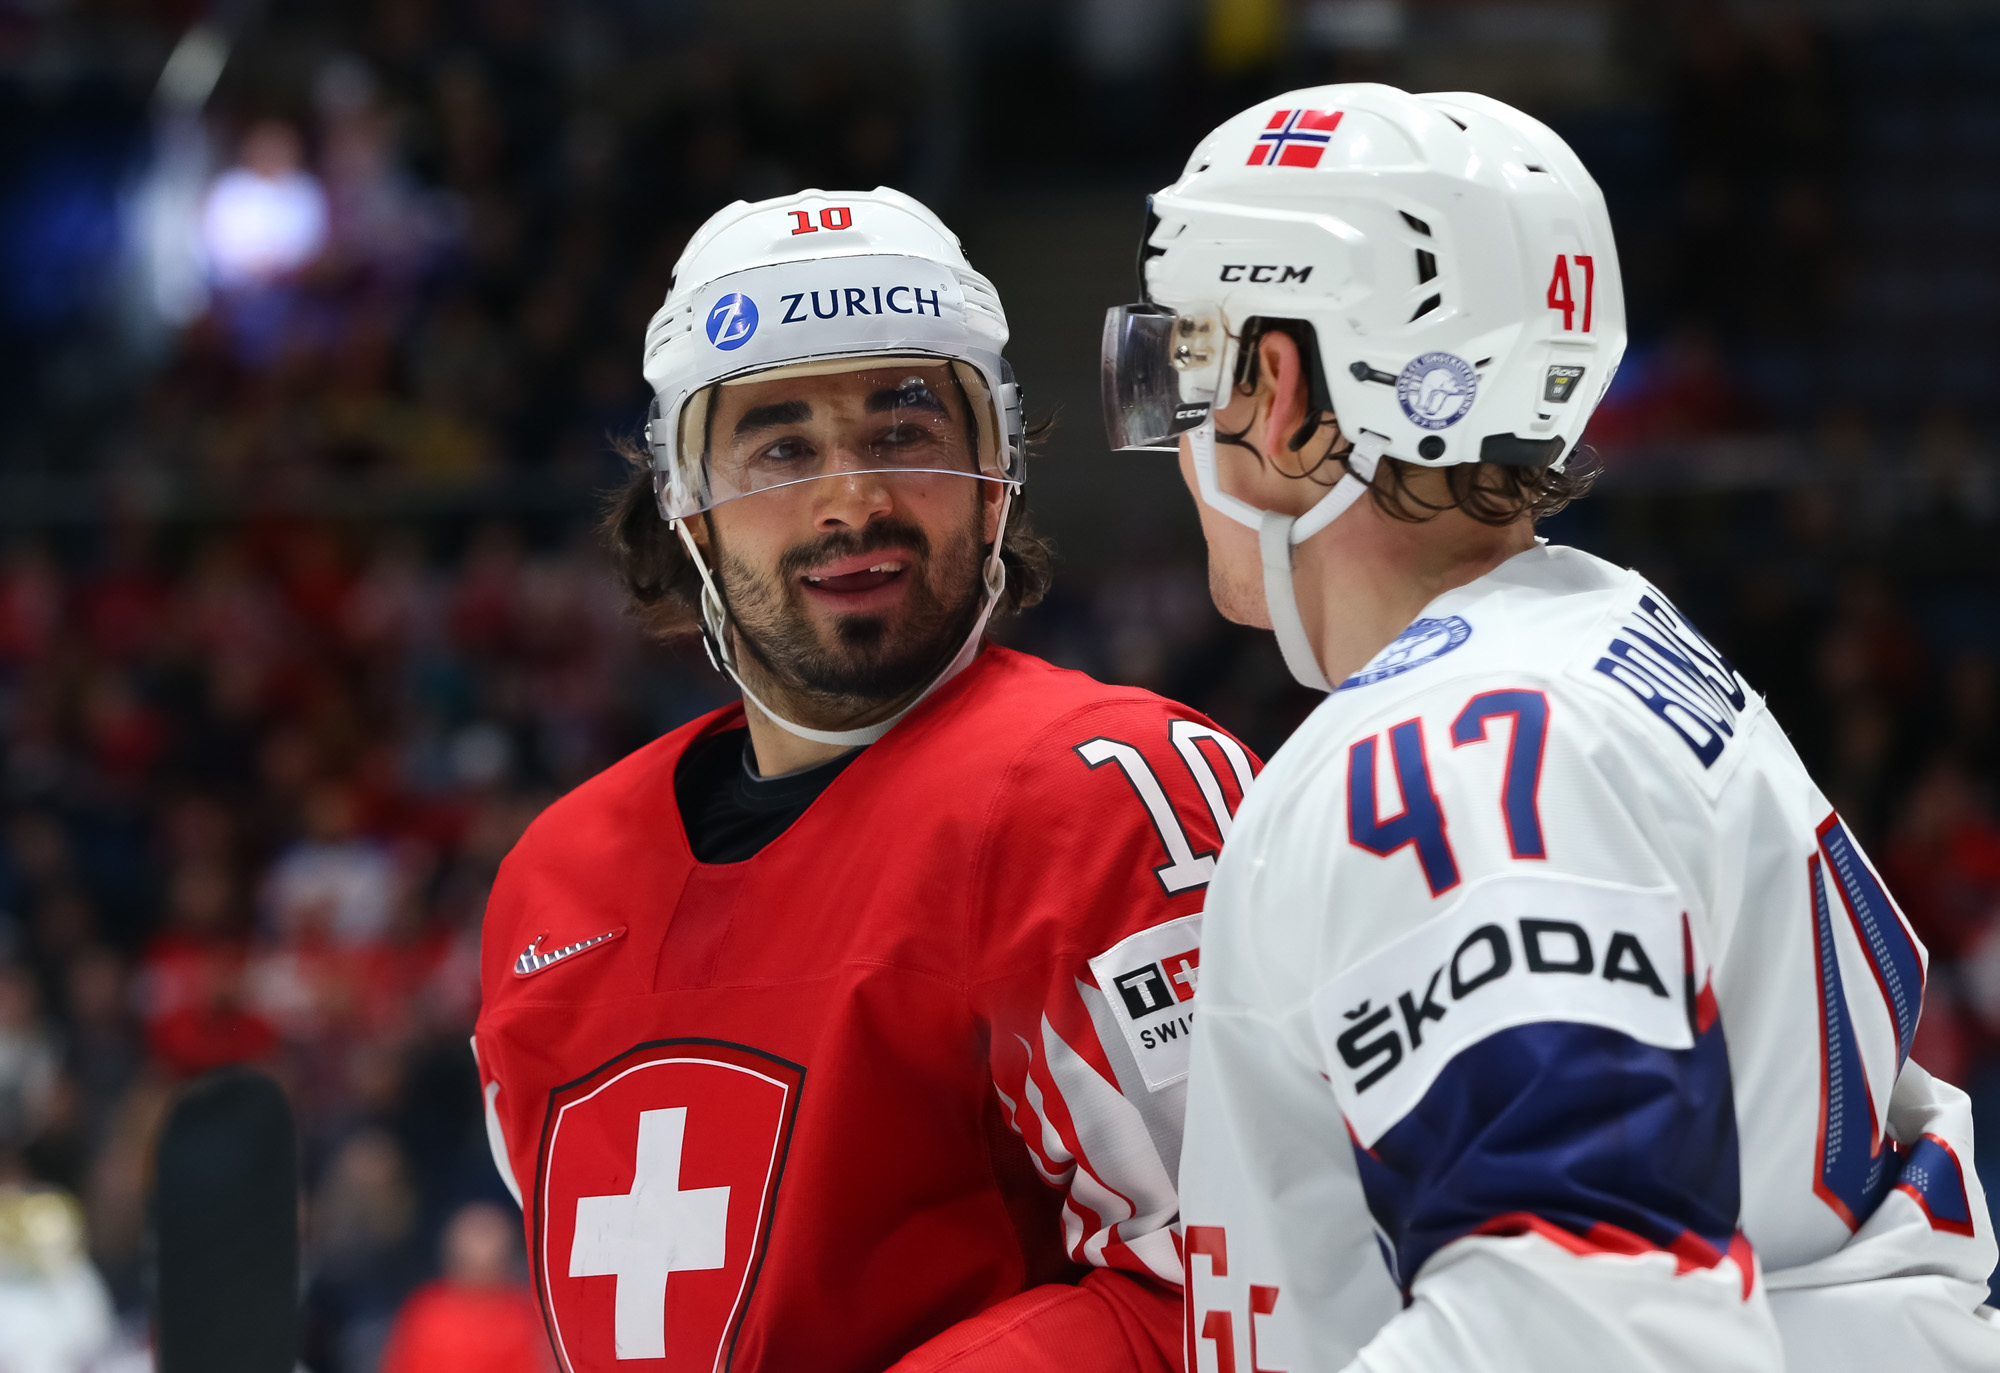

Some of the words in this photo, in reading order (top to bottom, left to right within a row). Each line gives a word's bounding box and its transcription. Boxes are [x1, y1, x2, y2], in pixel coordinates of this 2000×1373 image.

[788, 207, 852, 235] 10
[1219, 264, 1314, 284] CCM
[1546, 253, 1594, 333] 47
[780, 285, 942, 324] ZURICH
[1175, 408, 1209, 419] CCM
[1347, 687, 1551, 900] 47
[1336, 916, 1671, 1095] ŠKODA
